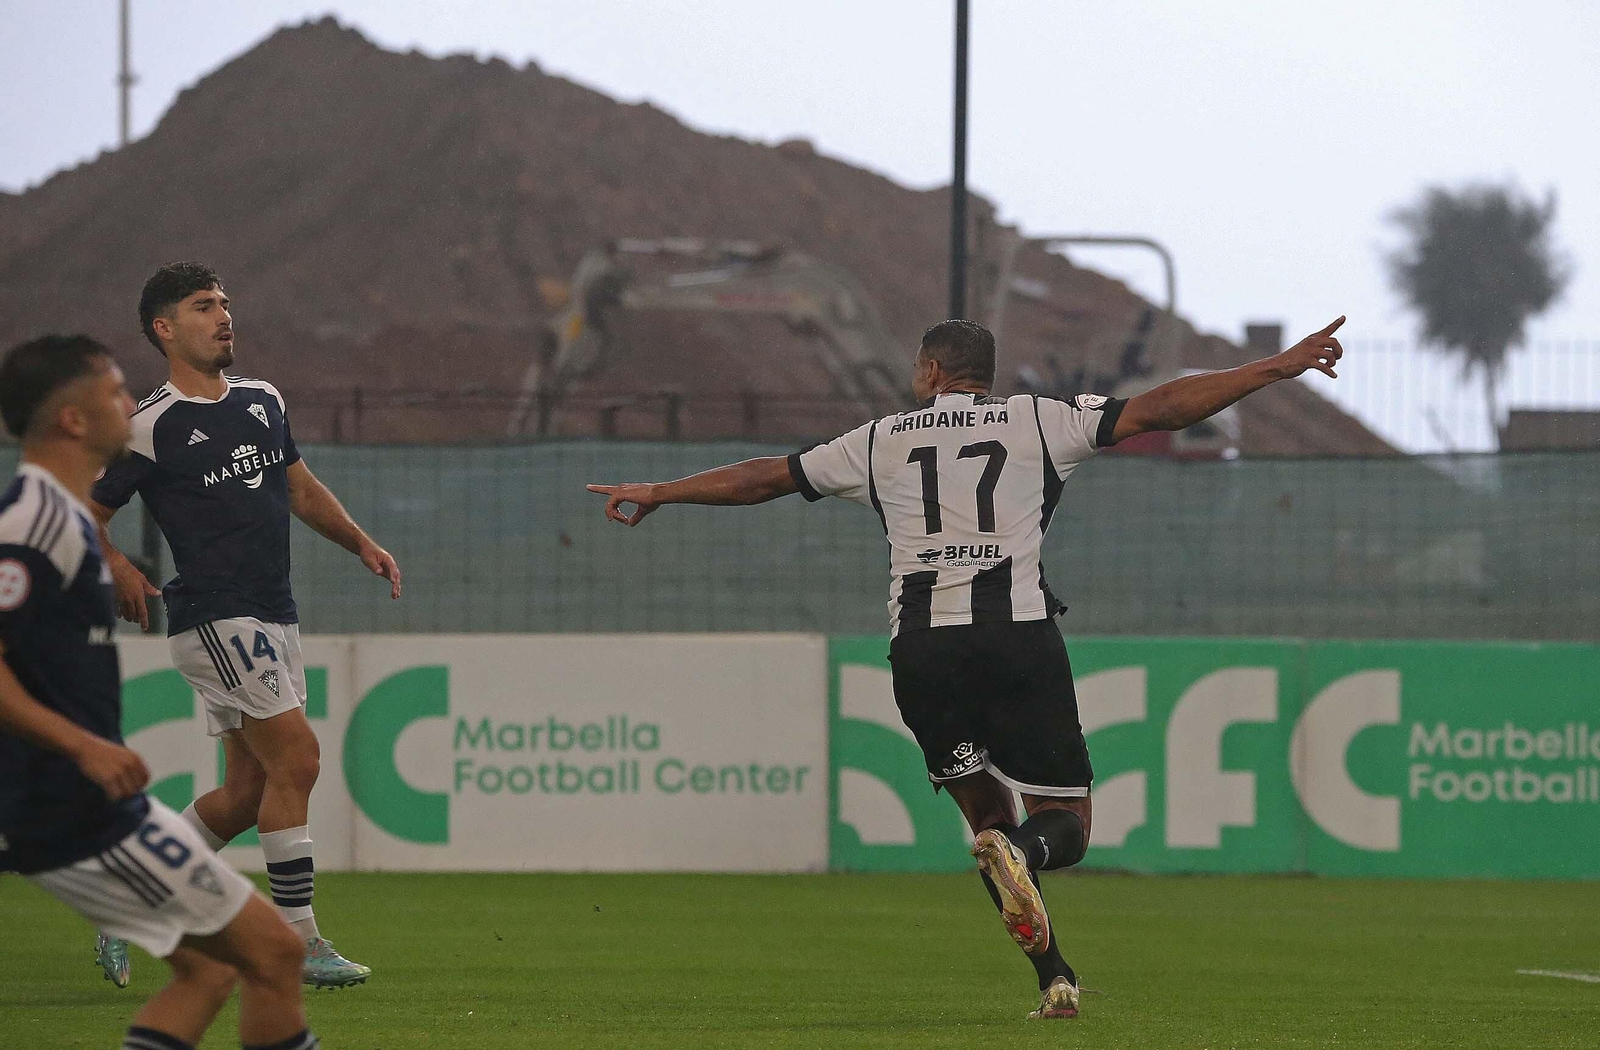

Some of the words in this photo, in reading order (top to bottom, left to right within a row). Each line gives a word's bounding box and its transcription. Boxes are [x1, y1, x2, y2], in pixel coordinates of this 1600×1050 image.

[890, 411, 977, 436] ARIDANE
[203, 448, 285, 487] MARBELLA
[906, 439, 1009, 536] 17
[229, 629, 279, 673] 14
[453, 714, 661, 753] Marbella
[453, 758, 641, 795] Football
[653, 758, 811, 795] Center
[1408, 765, 1600, 803] Football
[136, 821, 192, 870] 6
